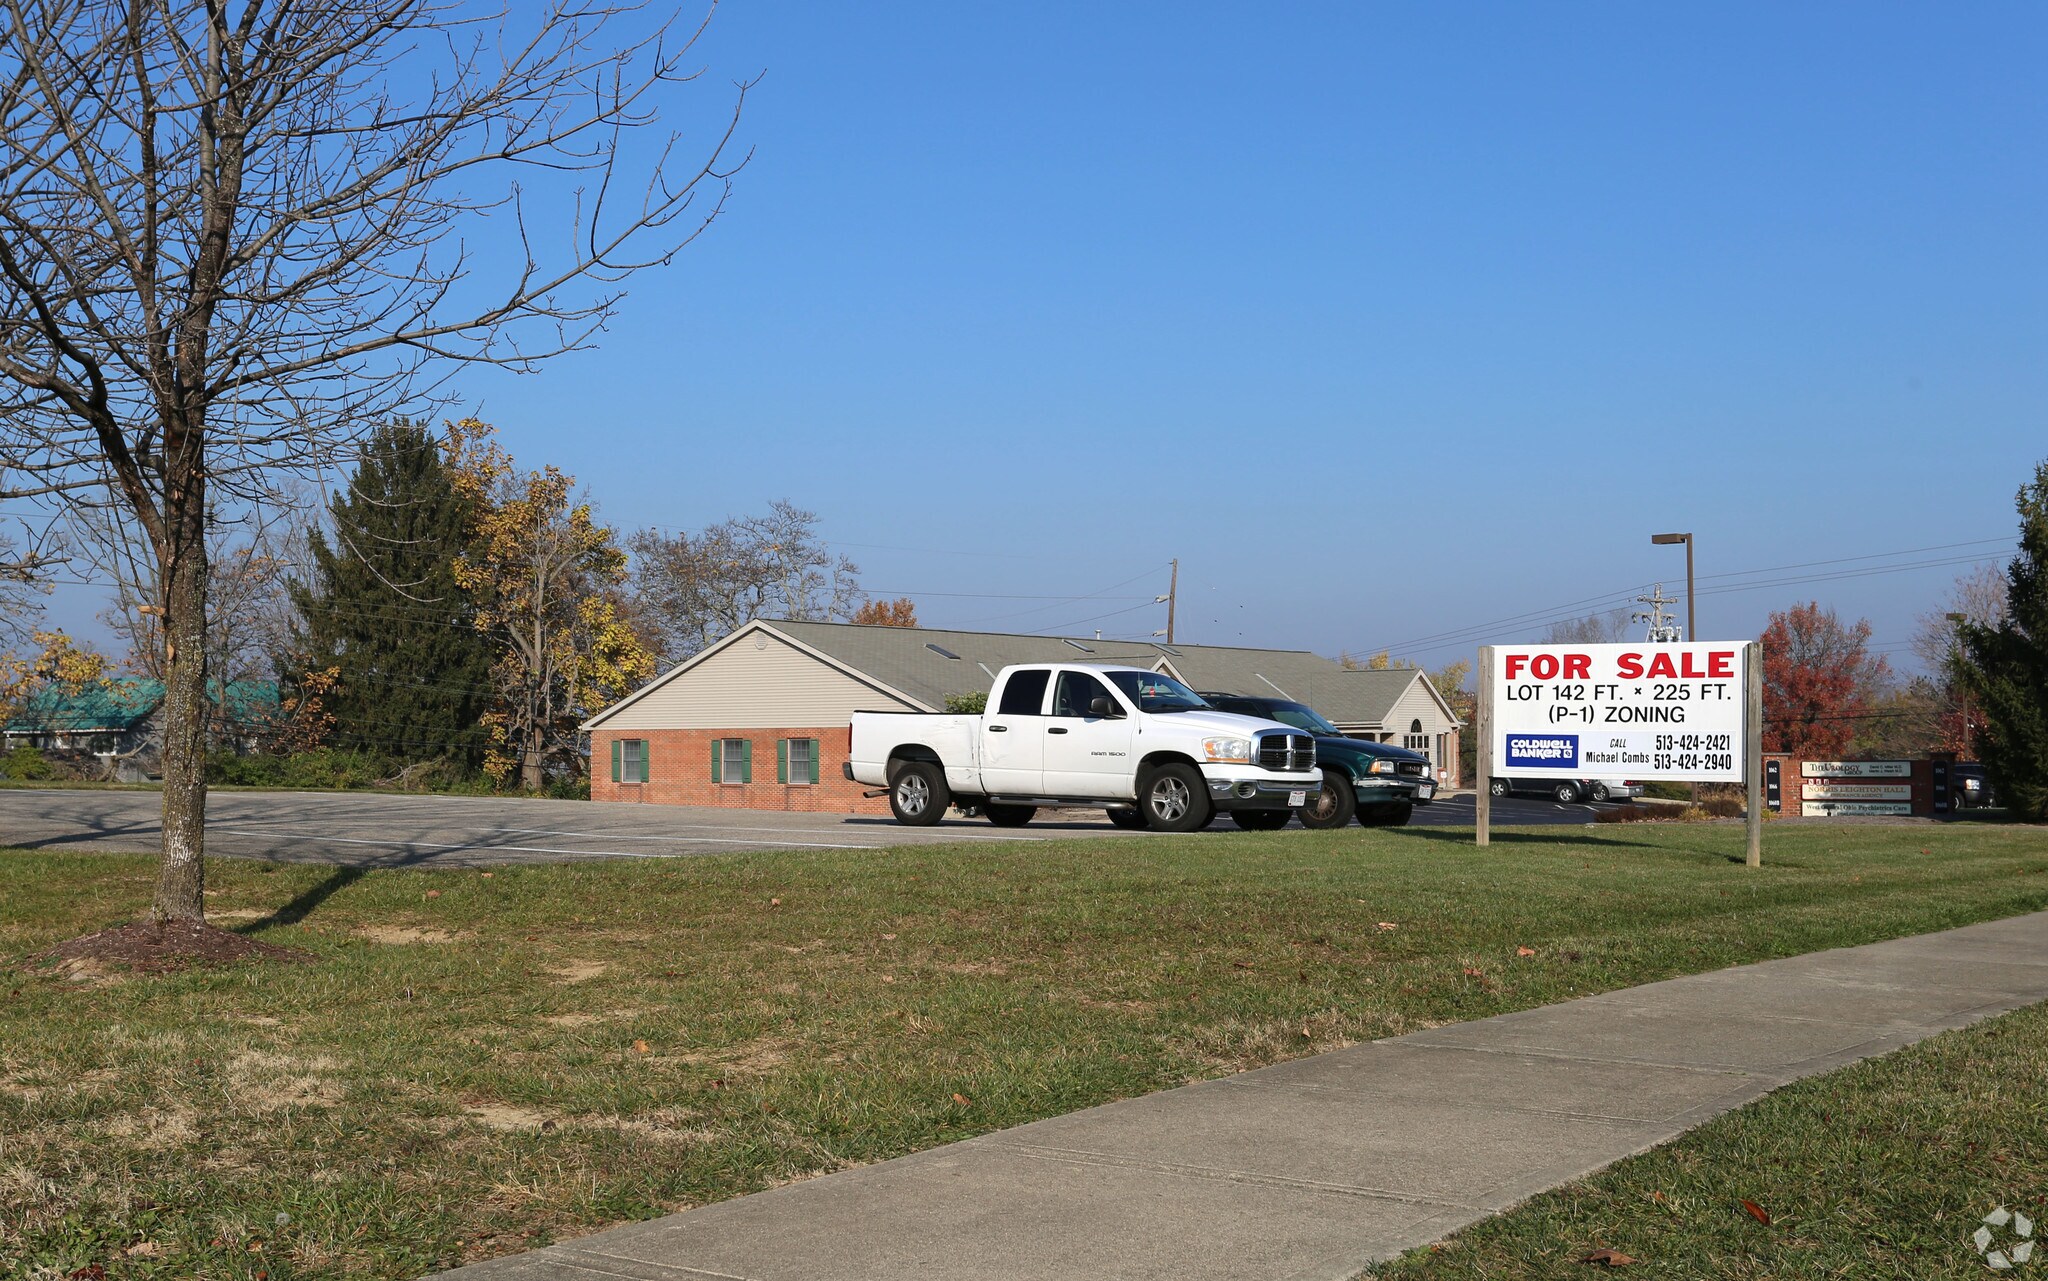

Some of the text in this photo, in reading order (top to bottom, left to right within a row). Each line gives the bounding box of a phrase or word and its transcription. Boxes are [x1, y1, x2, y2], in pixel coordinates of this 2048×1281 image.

[1505, 651, 1735, 680] FOR SALE
[1506, 684, 1544, 701] LOT
[1552, 684, 1585, 701] 142
[1594, 684, 1623, 701] FT.
[1653, 684, 1691, 701] 225
[1701, 683, 1732, 700] FT.
[1549, 704, 1686, 725] (P-1) ZONING
[1511, 739, 1573, 749] COLDWELL
[1609, 738, 1627, 748] CALL
[1655, 734, 1731, 751] 513-424-2421
[1511, 748, 1562, 759] BANKER
[1585, 751, 1619, 763] Michael
[1621, 751, 1650, 764] Combs
[1653, 753, 1732, 770] 513-424-2940
